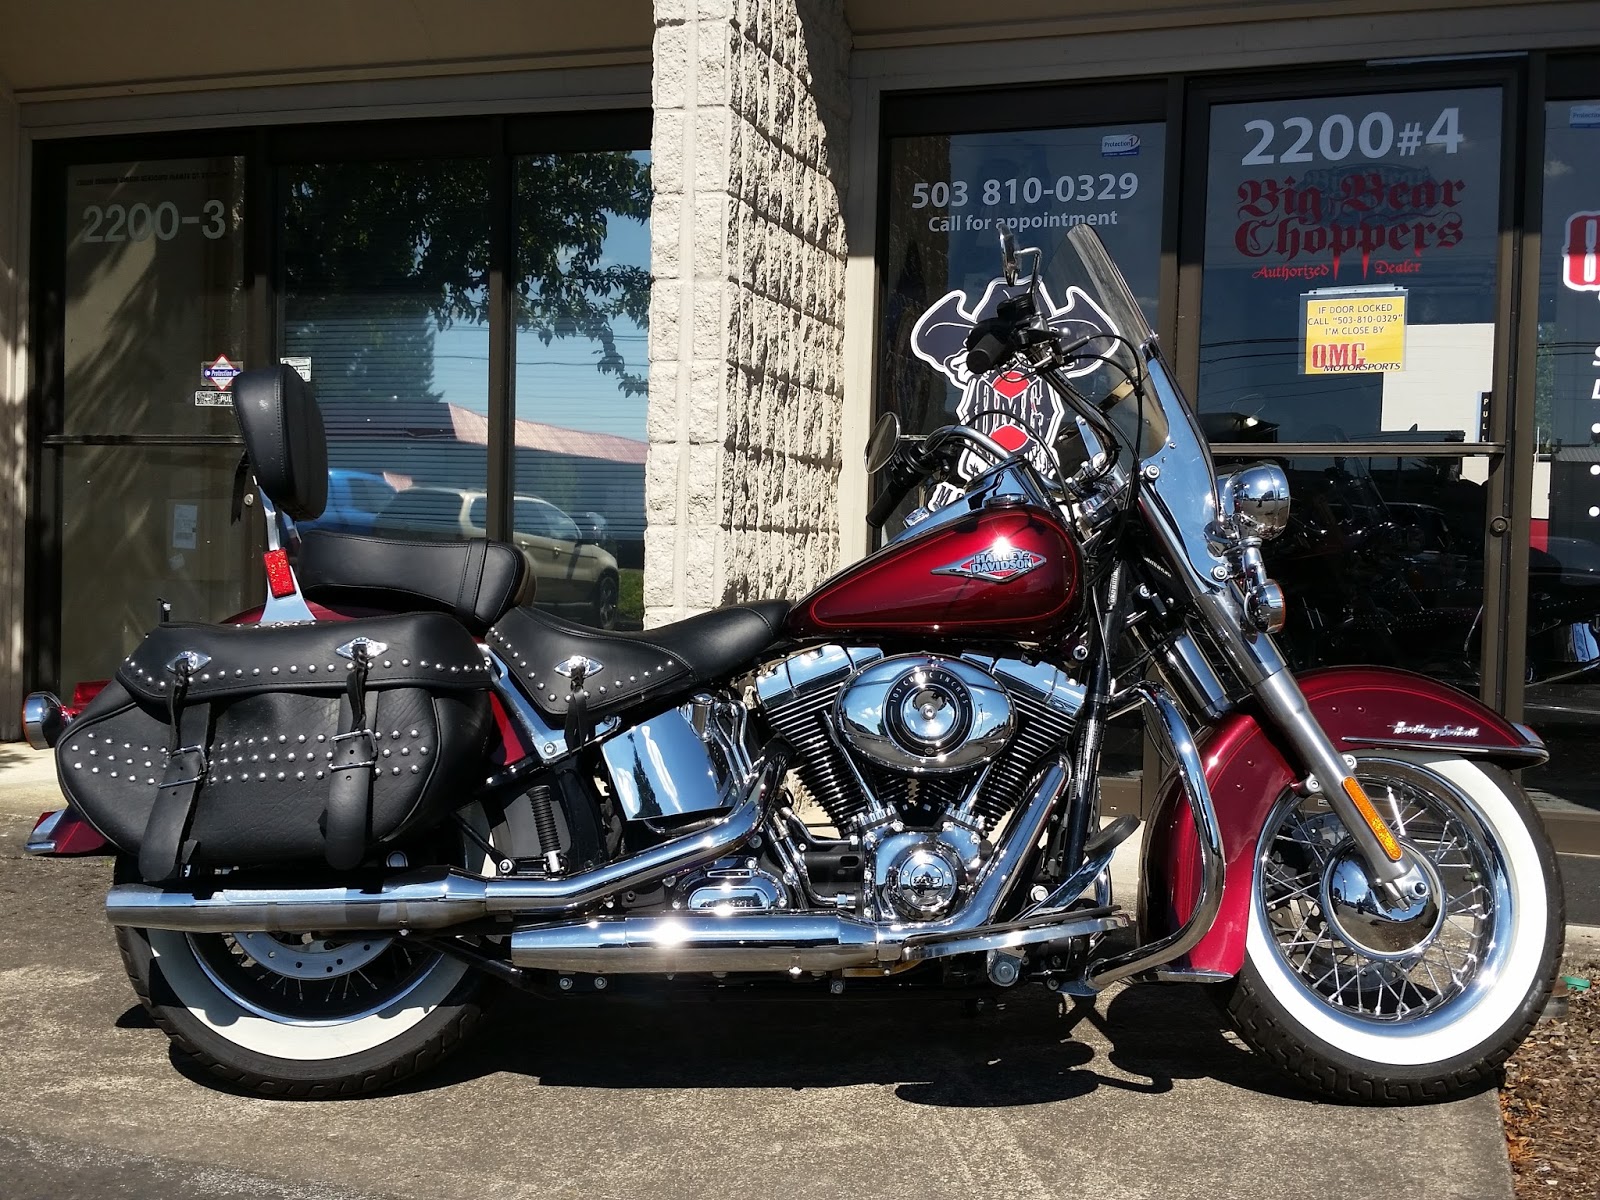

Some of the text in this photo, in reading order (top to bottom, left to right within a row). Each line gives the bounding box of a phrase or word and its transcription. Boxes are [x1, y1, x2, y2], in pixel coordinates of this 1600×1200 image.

[1241, 107, 1464, 166] 2200#4
[911, 172, 1138, 209] 503 810-0329
[1236, 172, 1466, 225] Big Bear
[82, 199, 226, 243] 2200-3
[928, 210, 1118, 233] Call for appointment
[1234, 212, 1464, 279] Choppers
[1252, 260, 1422, 281] Authorized Dealer
[1307, 317, 1329, 326] CALL
[1318, 303, 1393, 315] IF DOOR LOCKED
[1325, 325, 1385, 336] I'M CLOSE BY
[1312, 342, 1366, 369] OMG
[1323, 362, 1401, 372] MOTORSPORTS
[1481, 398, 1489, 442] PULL
[971, 558, 1034, 574] DAVIDSON
[903, 672, 933, 687] CUIC
[939, 674, 969, 704] INCHES
